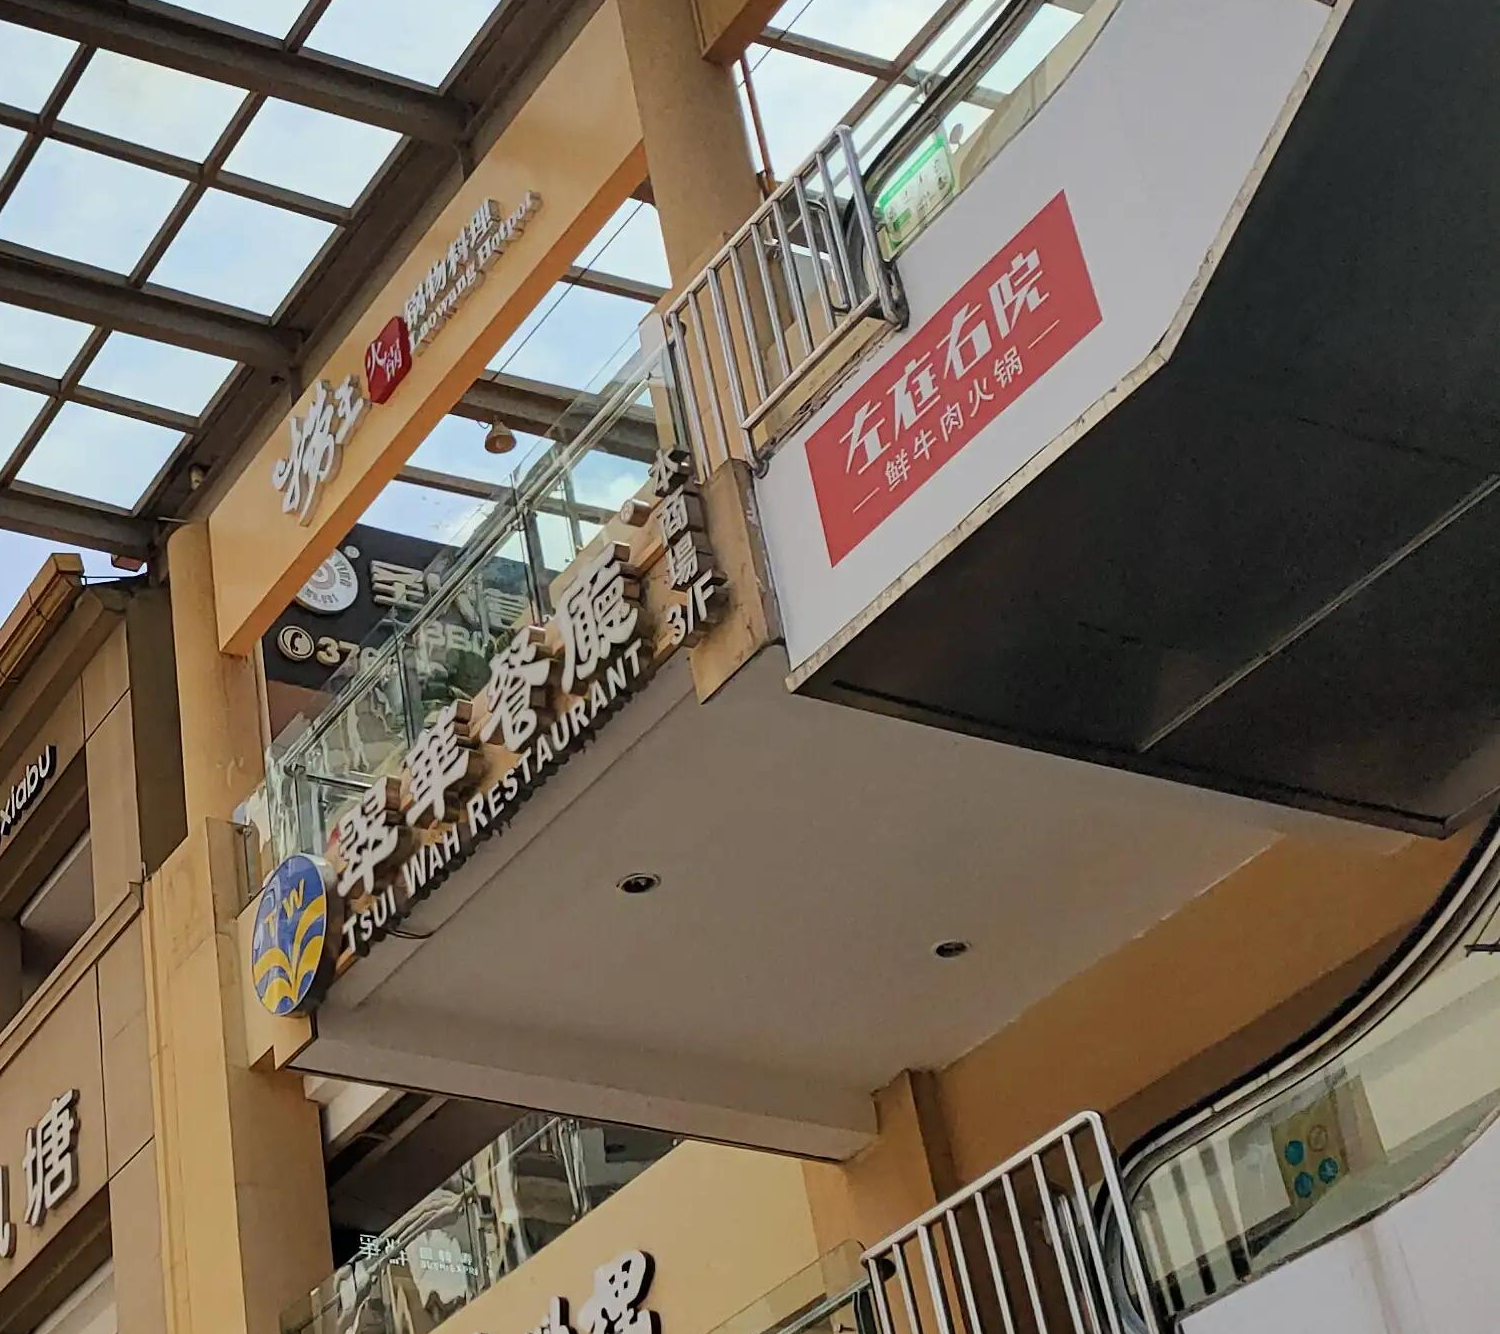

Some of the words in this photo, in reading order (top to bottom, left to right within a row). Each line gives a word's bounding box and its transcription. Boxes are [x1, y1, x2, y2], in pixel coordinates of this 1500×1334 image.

[404, 198, 498, 325] 锅物料理
[409, 267, 482, 353] Laowang
[478, 191, 540, 264] Hotpot
[367, 339, 403, 381] 火锅
[839, 247, 1049, 475] 左庭右院
[884, 343, 1023, 494] 鲜牛肉火锅
[272, 375, 364, 526] 捞王
[667, 570, 716, 645] 3/F
[337, 541, 638, 897] 翠華餐廳
[342, 894, 396, 951] TSUI
[401, 824, 461, 899] WAH
[467, 641, 643, 837] RESTAURANT
